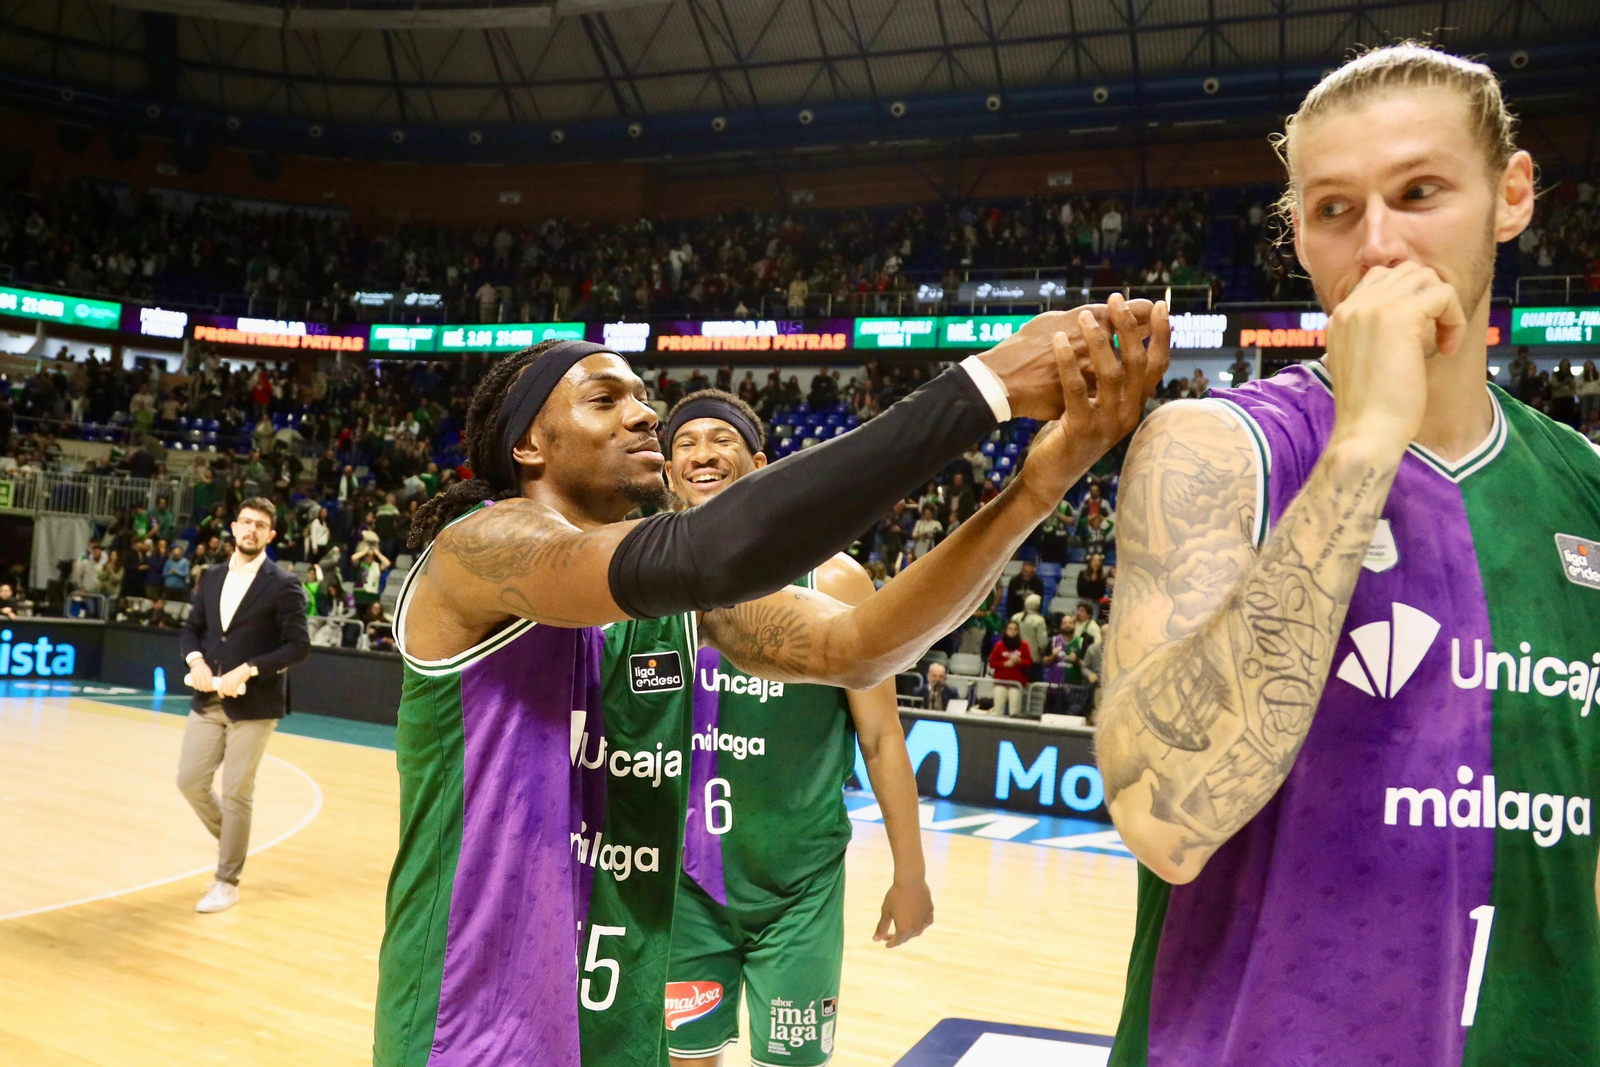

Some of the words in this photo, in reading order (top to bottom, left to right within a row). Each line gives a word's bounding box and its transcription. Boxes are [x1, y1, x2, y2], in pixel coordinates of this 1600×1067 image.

[301, 335, 364, 351] PATRAS
[657, 335, 771, 351] PROMITHEAS
[772, 334, 846, 350] PATRAS
[1170, 330, 1223, 348] PARTIDO
[1545, 326, 1582, 342] GAME
[1584, 326, 1592, 342] 1
[1564, 549, 1588, 566] liga
[635, 666, 655, 678] liga
[636, 675, 680, 687] endesa
[701, 668, 784, 703] Uncaja
[704, 778, 733, 835] 6
[1384, 765, 1591, 848] málaga
[575, 920, 626, 1012] 5
[1461, 904, 1496, 1026] 1
[771, 997, 793, 1007] sabor
[770, 1006, 777, 1016] a
[777, 1000, 818, 1025] má
[769, 1017, 818, 1048] laga
